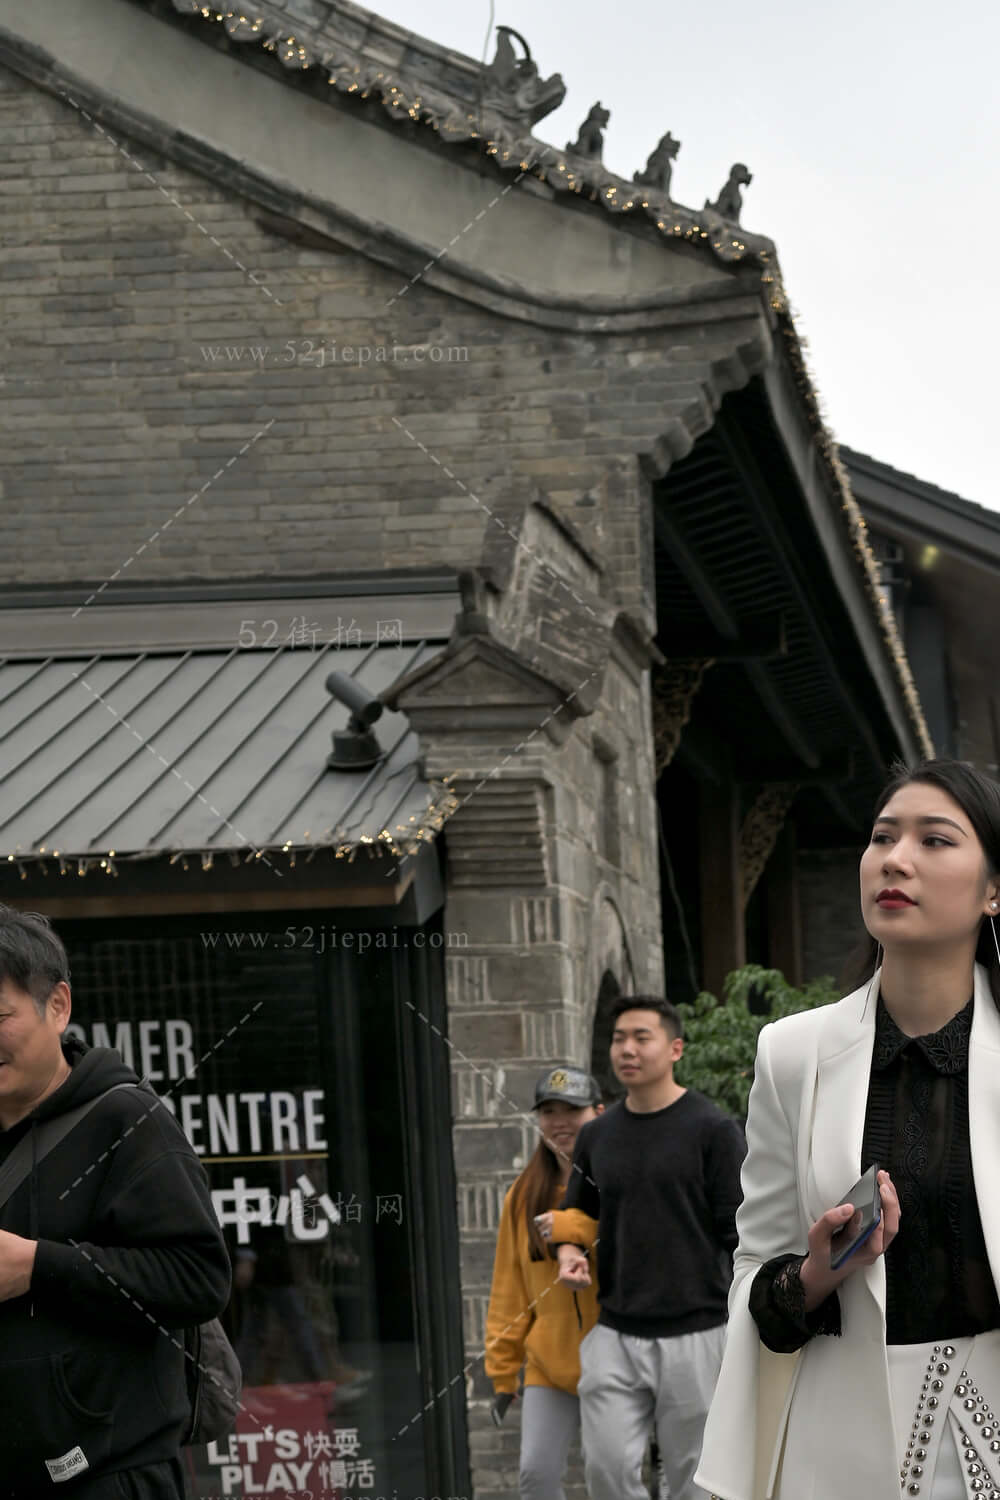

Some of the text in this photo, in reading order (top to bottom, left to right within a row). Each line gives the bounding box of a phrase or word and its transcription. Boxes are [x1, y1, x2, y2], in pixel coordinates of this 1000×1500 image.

[160, 1089, 328, 1156] ENTRE
[210, 1174, 342, 1245] 中心
[206, 1424, 300, 1465] LET'S
[220, 1461, 314, 1496] PLAY
